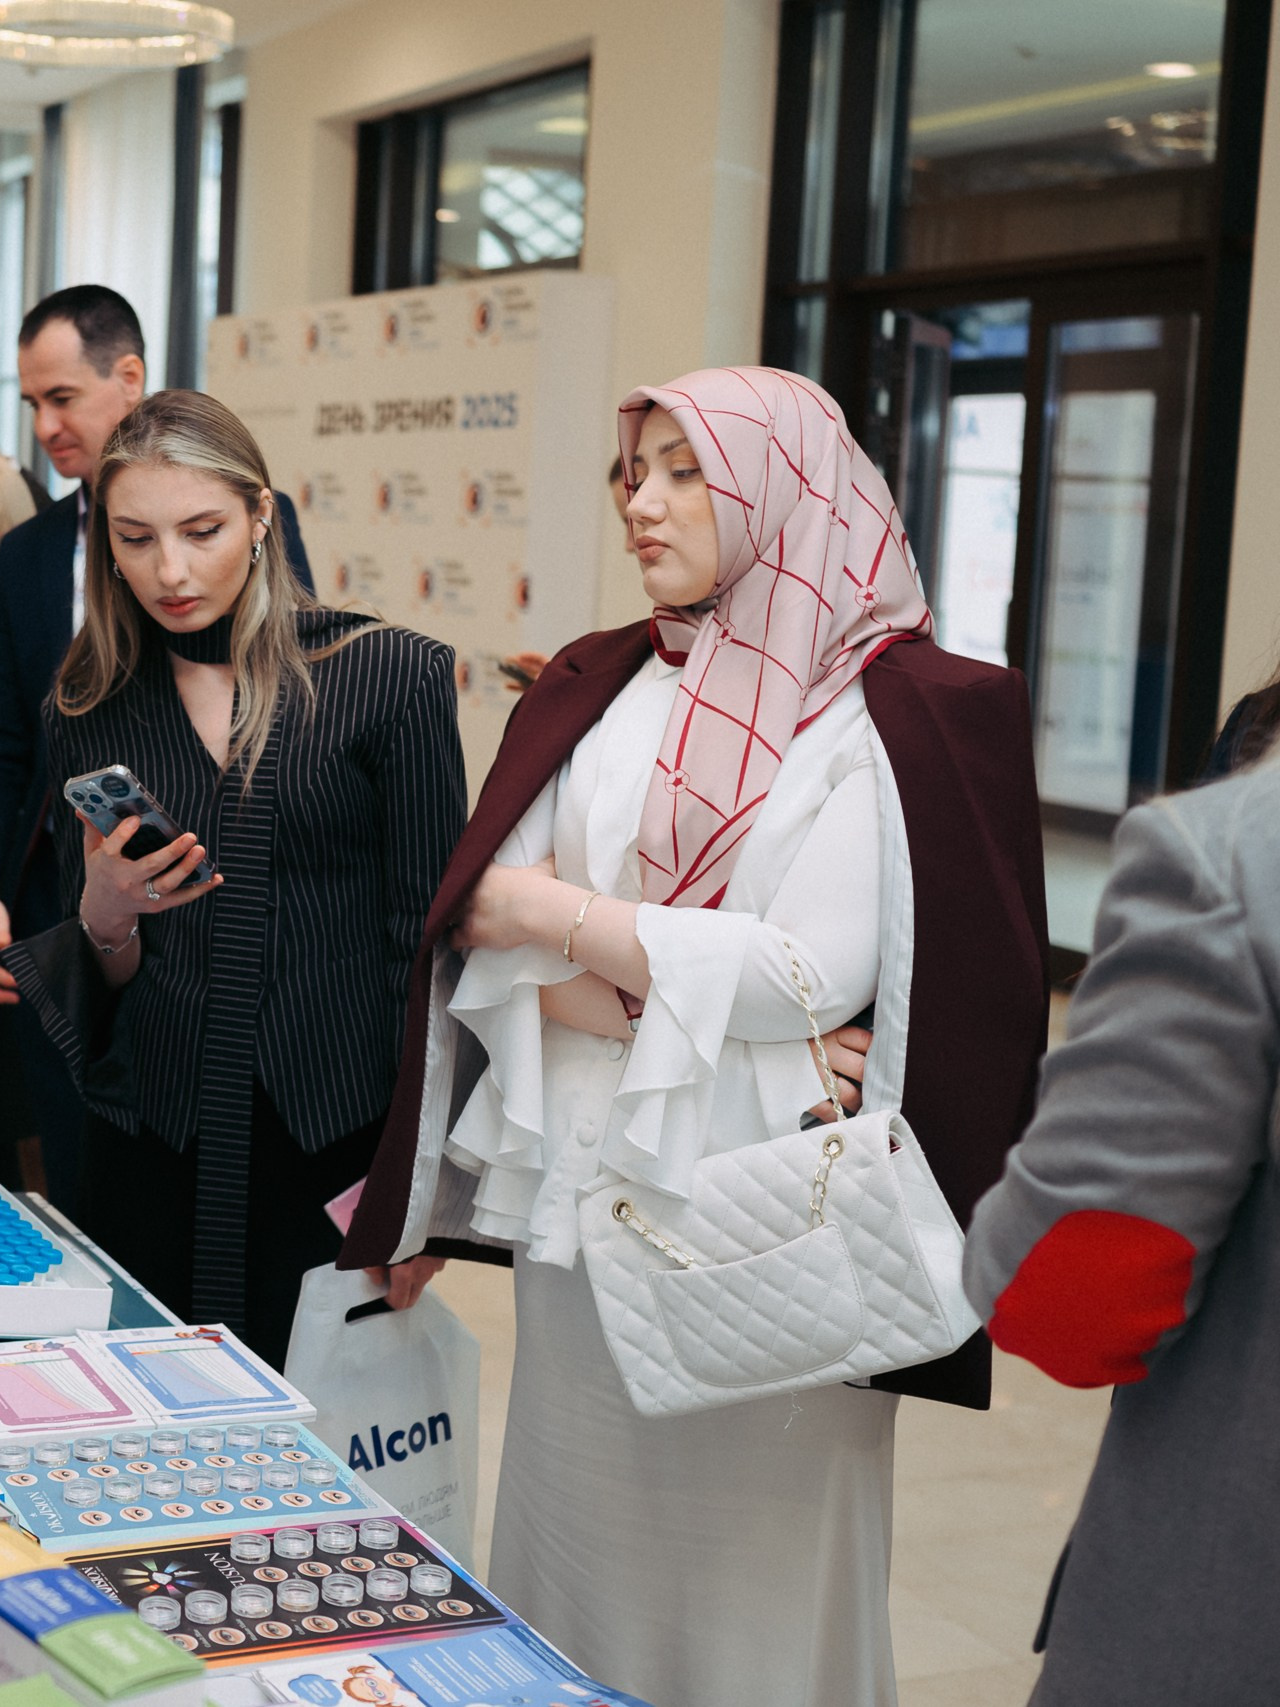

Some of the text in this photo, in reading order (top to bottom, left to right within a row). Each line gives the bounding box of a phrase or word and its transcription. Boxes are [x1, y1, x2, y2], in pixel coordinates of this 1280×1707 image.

[316, 393, 517, 436] ДЕНЬ ЗРЕНИЯ 2025
[348, 1411, 452, 1474] Alcon
